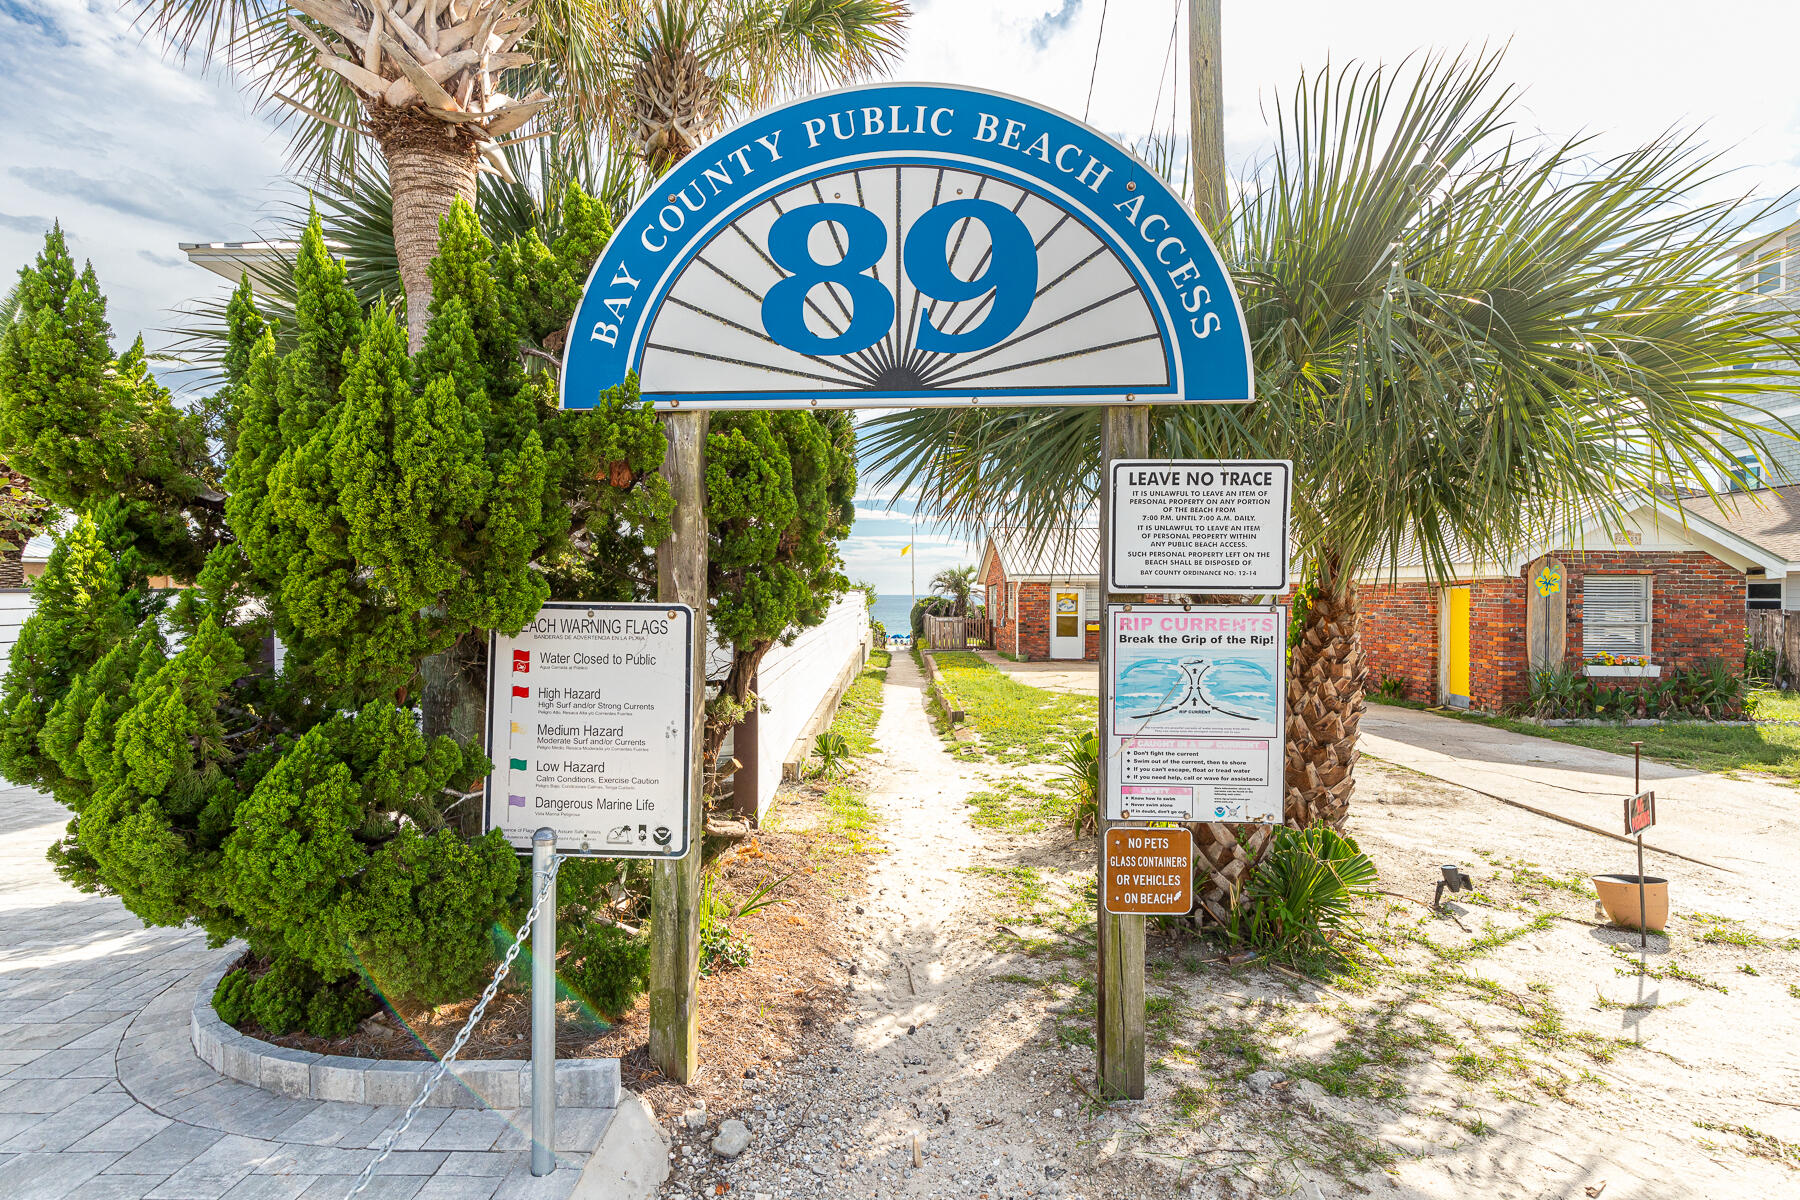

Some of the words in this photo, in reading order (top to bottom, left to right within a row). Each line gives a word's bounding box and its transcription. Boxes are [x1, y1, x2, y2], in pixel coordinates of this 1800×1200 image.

[591, 259, 642, 349] BAY
[640, 129, 786, 254] COUNTY
[801, 105, 954, 150] PUBLIC
[974, 112, 1114, 192] BEACH
[1114, 193, 1223, 340] ACCESS
[761, 199, 1038, 356] 89
[1129, 472, 1180, 486] LEAVE
[1187, 472, 1213, 486] NO
[1220, 472, 1272, 486] TRACE
[521, 618, 555, 632] EACH
[561, 619, 621, 634] WARNING
[626, 620, 668, 634] FLAGS
[1120, 617, 1152, 631] RIP
[1160, 618, 1273, 632] CURRENTS
[1120, 635, 1154, 643] Break
[1159, 635, 1177, 643] the
[1182, 635, 1206, 646] Grip
[1211, 635, 1222, 644] of
[1227, 635, 1246, 644] the
[1250, 636, 1273, 646] Rip!
[540, 652, 570, 664] Water
[574, 653, 609, 664] Closed
[613, 653, 622, 665] to
[626, 653, 656, 665] Public
[539, 688, 560, 701] High
[565, 688, 600, 699] Hazard
[538, 701, 554, 709] High
[598, 702, 621, 711] Strong
[538, 724, 579, 736] Medium
[584, 725, 623, 736] Hazard
[536, 760, 560, 772] Low
[564, 761, 605, 772] Hazard
[536, 797, 593, 811] Dangerous
[597, 798, 632, 810] Marine
[637, 799, 654, 810] Life
[1128, 838, 1142, 849] NO
[1144, 838, 1169, 849] PETS
[1111, 856, 1136, 867] GLASS
[1138, 857, 1187, 867] CONTAINERS
[1117, 875, 1130, 885] OR
[1133, 875, 1180, 886] VEHICLES
[1124, 893, 1139, 904] ON
[1141, 893, 1173, 904] BEACH
